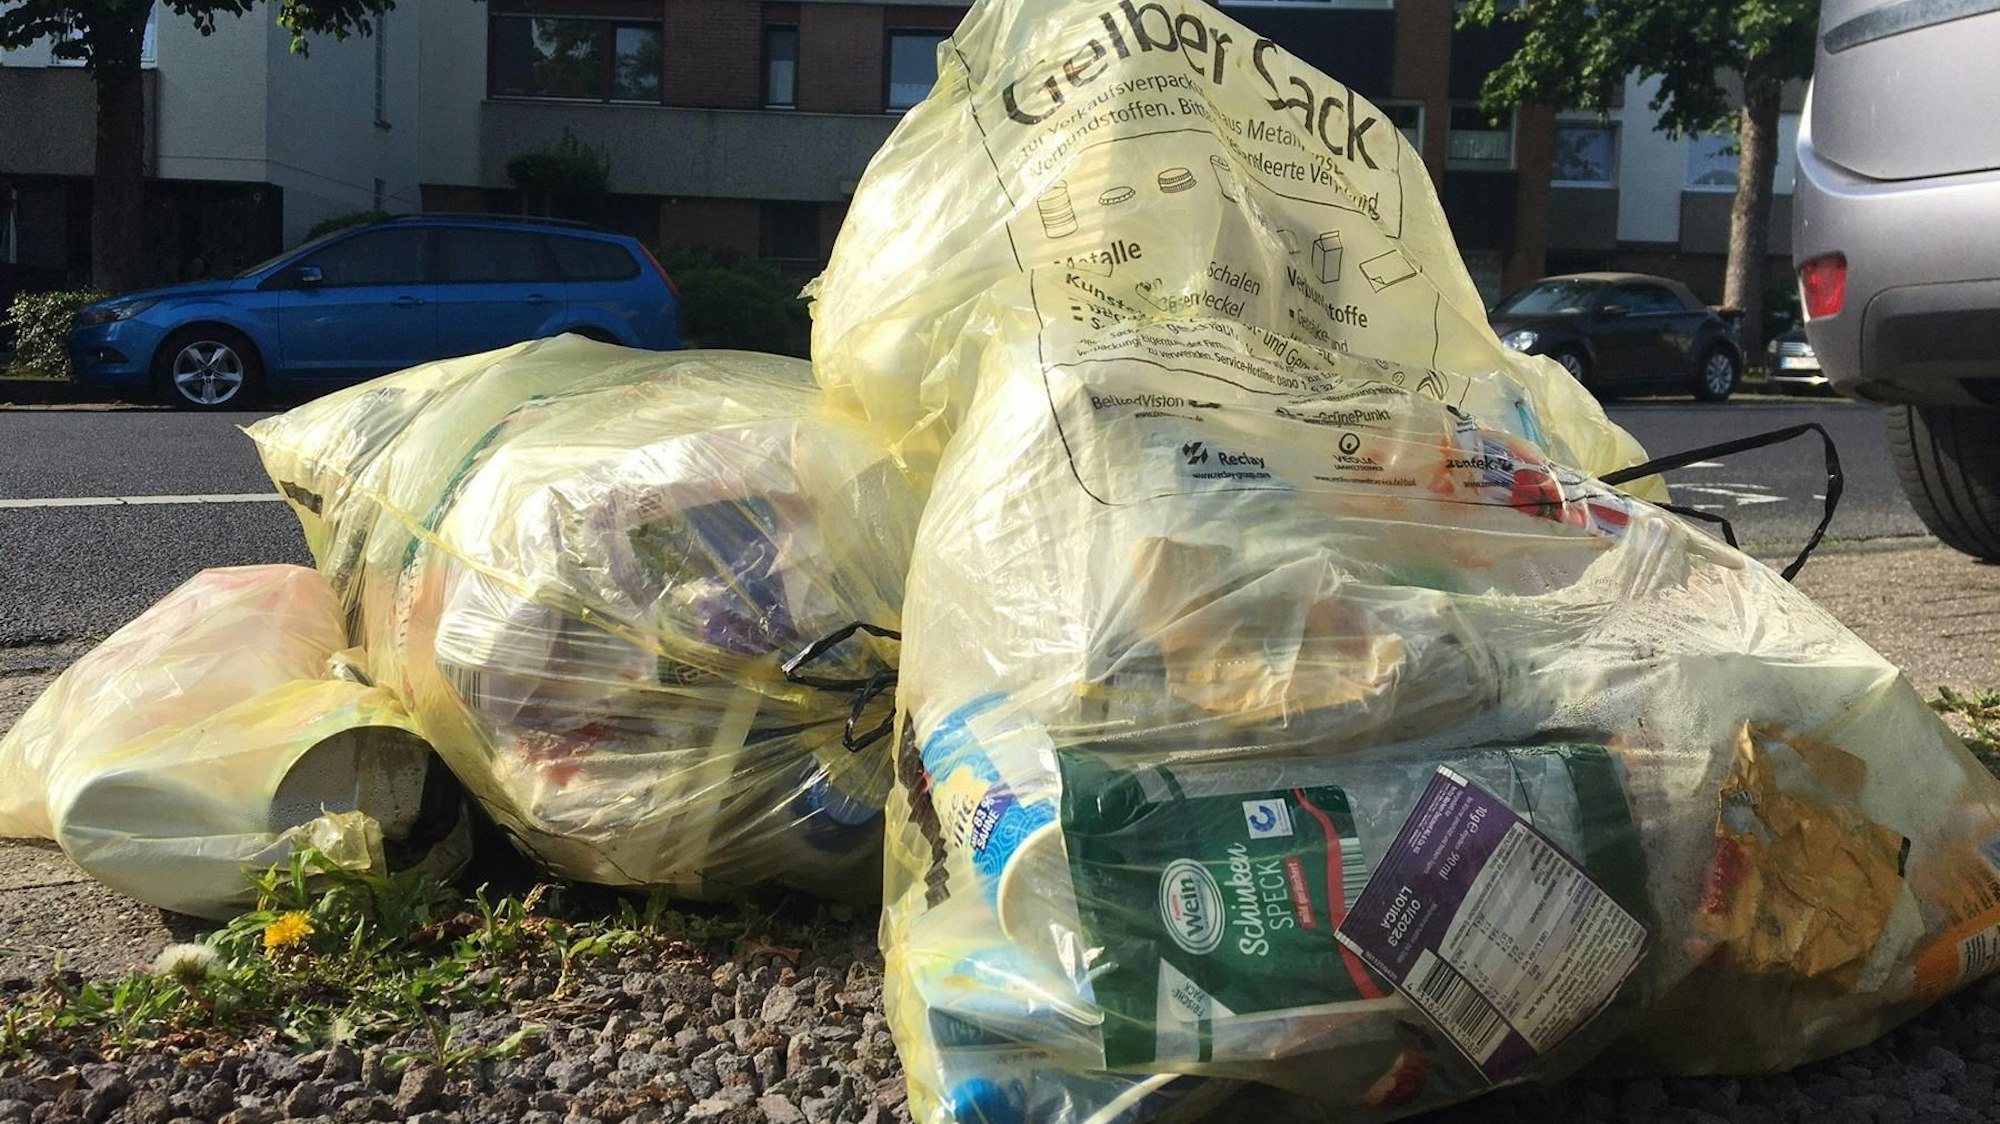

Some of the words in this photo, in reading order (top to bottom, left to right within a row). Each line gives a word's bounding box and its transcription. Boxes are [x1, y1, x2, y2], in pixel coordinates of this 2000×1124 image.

[1002, 0, 1232, 125] Gelber
[1254, 38, 1380, 170] Sack
[1208, 261, 1261, 297] Schalen
[1218, 452, 1265, 469] Reclay
[977, 809, 1000, 850] SAHNE
[1445, 850, 1461, 866] 90
[1180, 876, 1205, 938] Wein
[1223, 842, 1270, 957] Schinken
[1256, 854, 1295, 932] SPECK
[1385, 897, 1422, 948] 01/2023
